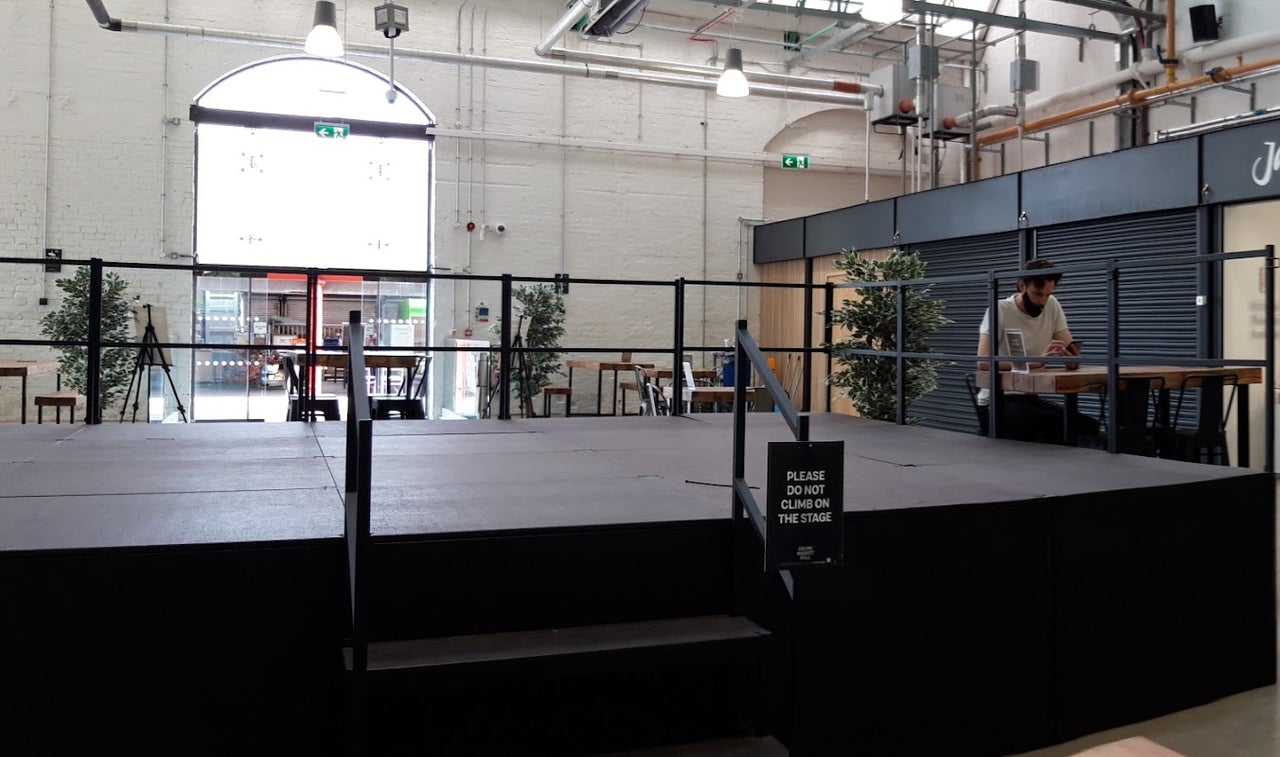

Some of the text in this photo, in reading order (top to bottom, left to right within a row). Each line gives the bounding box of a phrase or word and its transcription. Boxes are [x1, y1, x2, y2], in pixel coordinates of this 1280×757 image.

[787, 470, 826, 481] PLEASE
[787, 484, 826, 495] DO NOT
[781, 498, 830, 510] CLIMB ON
[778, 512, 832, 524] THE STAGE
